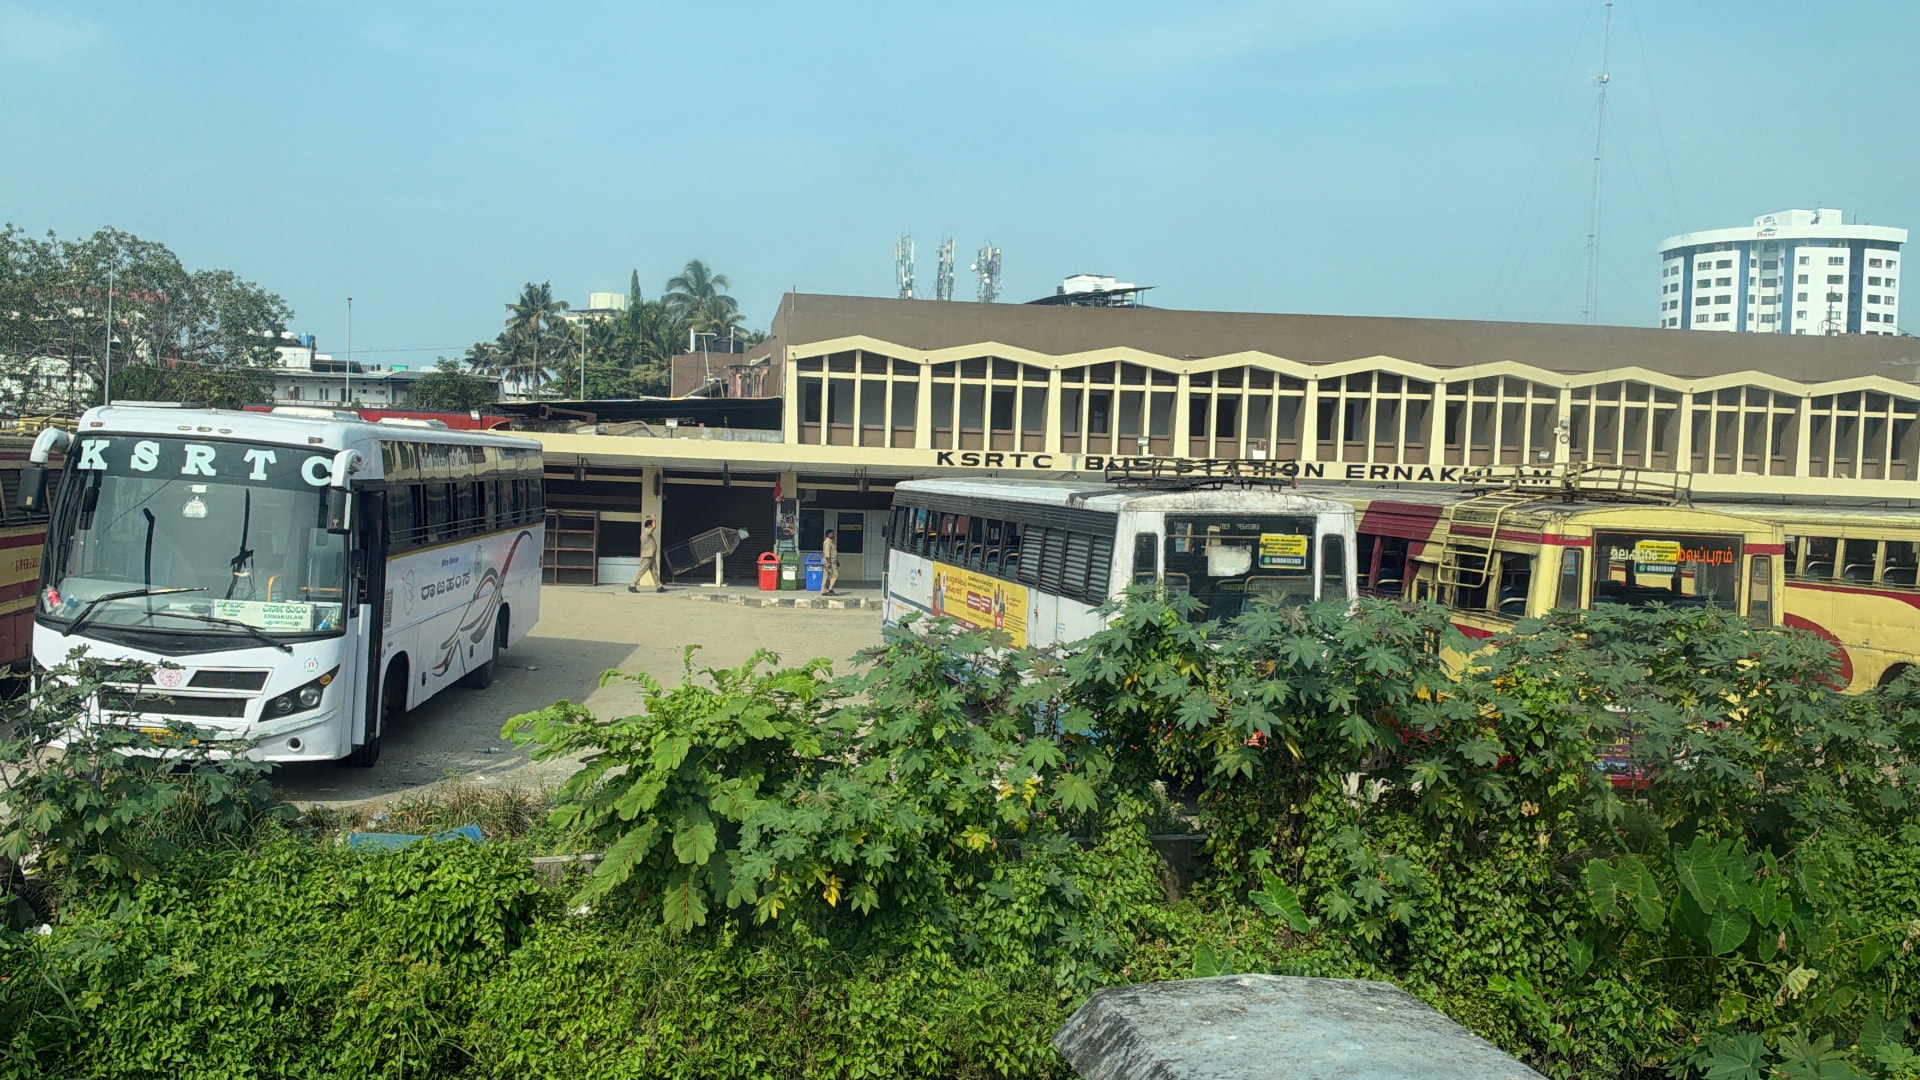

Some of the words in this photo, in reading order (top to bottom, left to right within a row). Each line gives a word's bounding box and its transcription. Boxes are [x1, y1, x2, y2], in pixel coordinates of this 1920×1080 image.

[77, 439, 333, 486] KSRTC
[937, 451, 1053, 468] KSRTC
[1085, 456, 1154, 472] BUS
[421, 568, 471, 600] ರಾಜಹಂಸ
